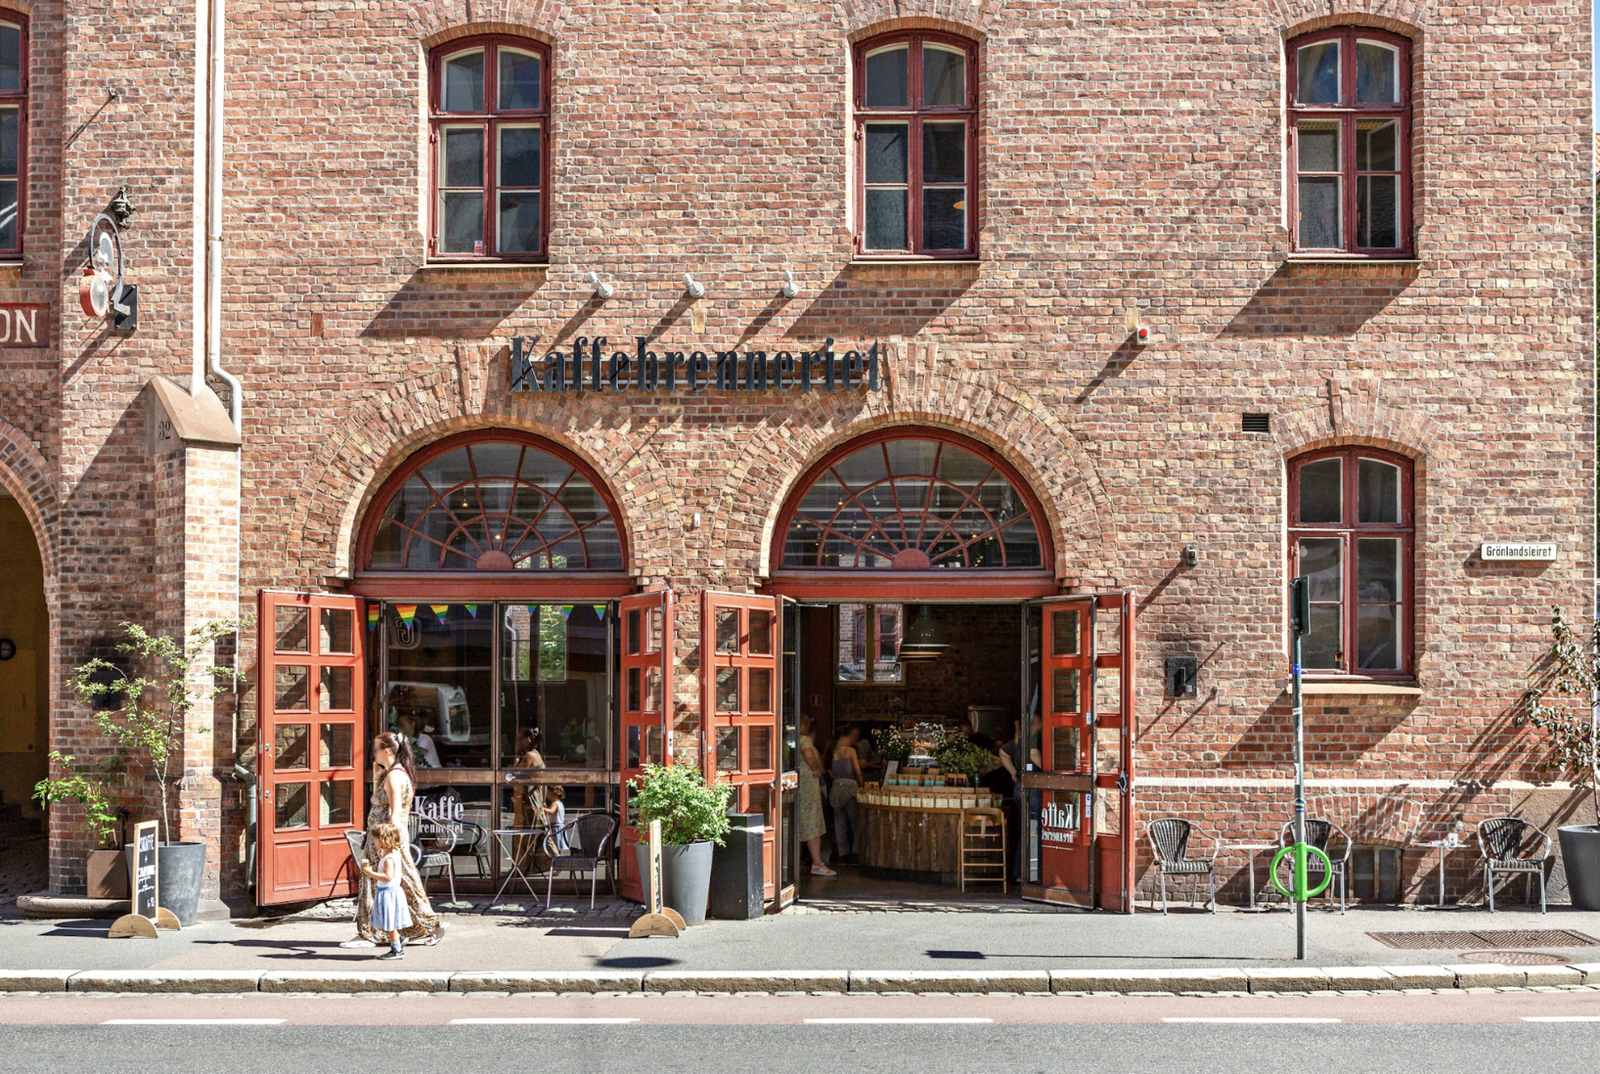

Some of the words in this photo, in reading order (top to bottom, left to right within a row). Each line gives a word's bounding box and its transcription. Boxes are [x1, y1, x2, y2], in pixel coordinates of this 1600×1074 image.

[511, 336, 883, 392] Kaffebrenneriet
[159, 421, 171, 440] 32
[1486, 545, 1552, 557] Grönlandsleiret
[414, 795, 465, 821] Kaffe
